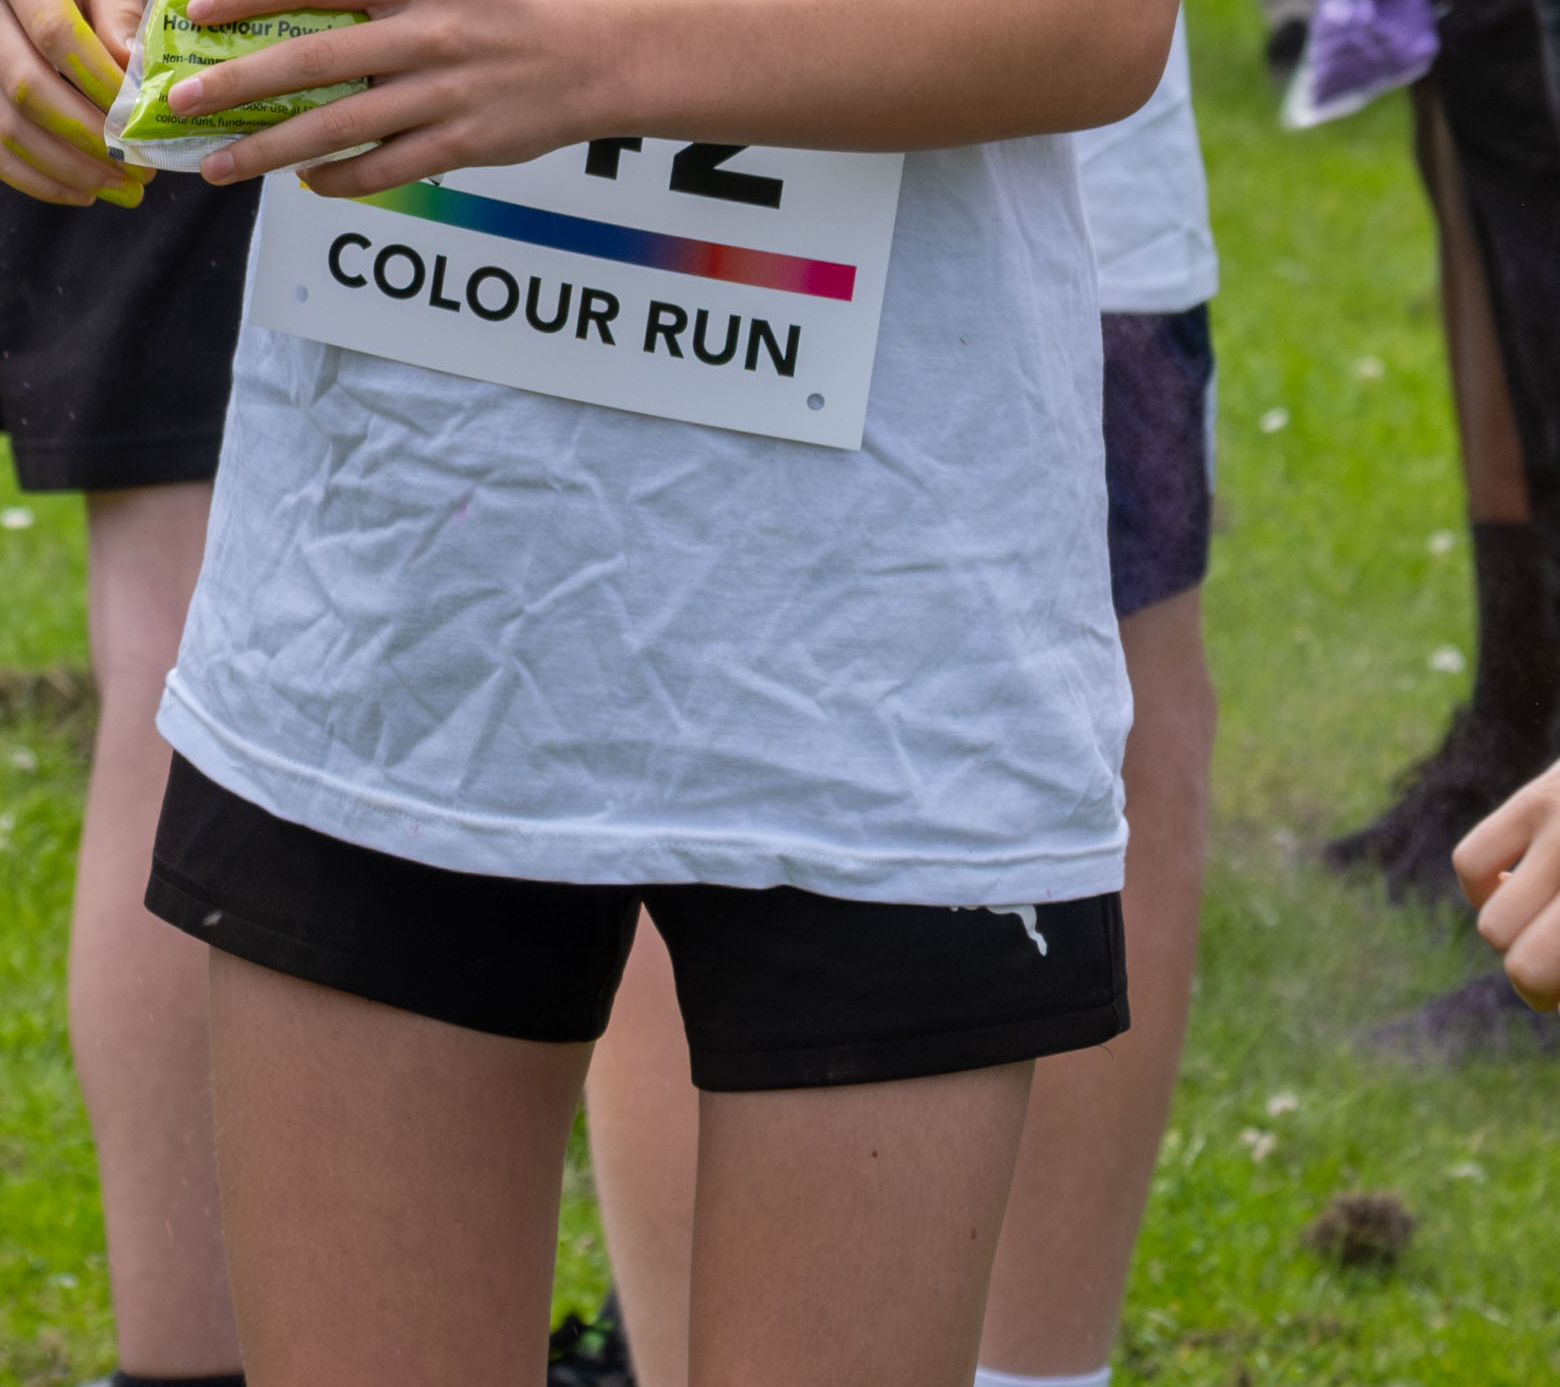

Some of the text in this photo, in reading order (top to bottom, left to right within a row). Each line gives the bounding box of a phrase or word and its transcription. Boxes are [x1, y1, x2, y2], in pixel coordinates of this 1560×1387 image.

[155, 113, 188, 124] colour
[327, 232, 801, 378] COLOUR RUN
